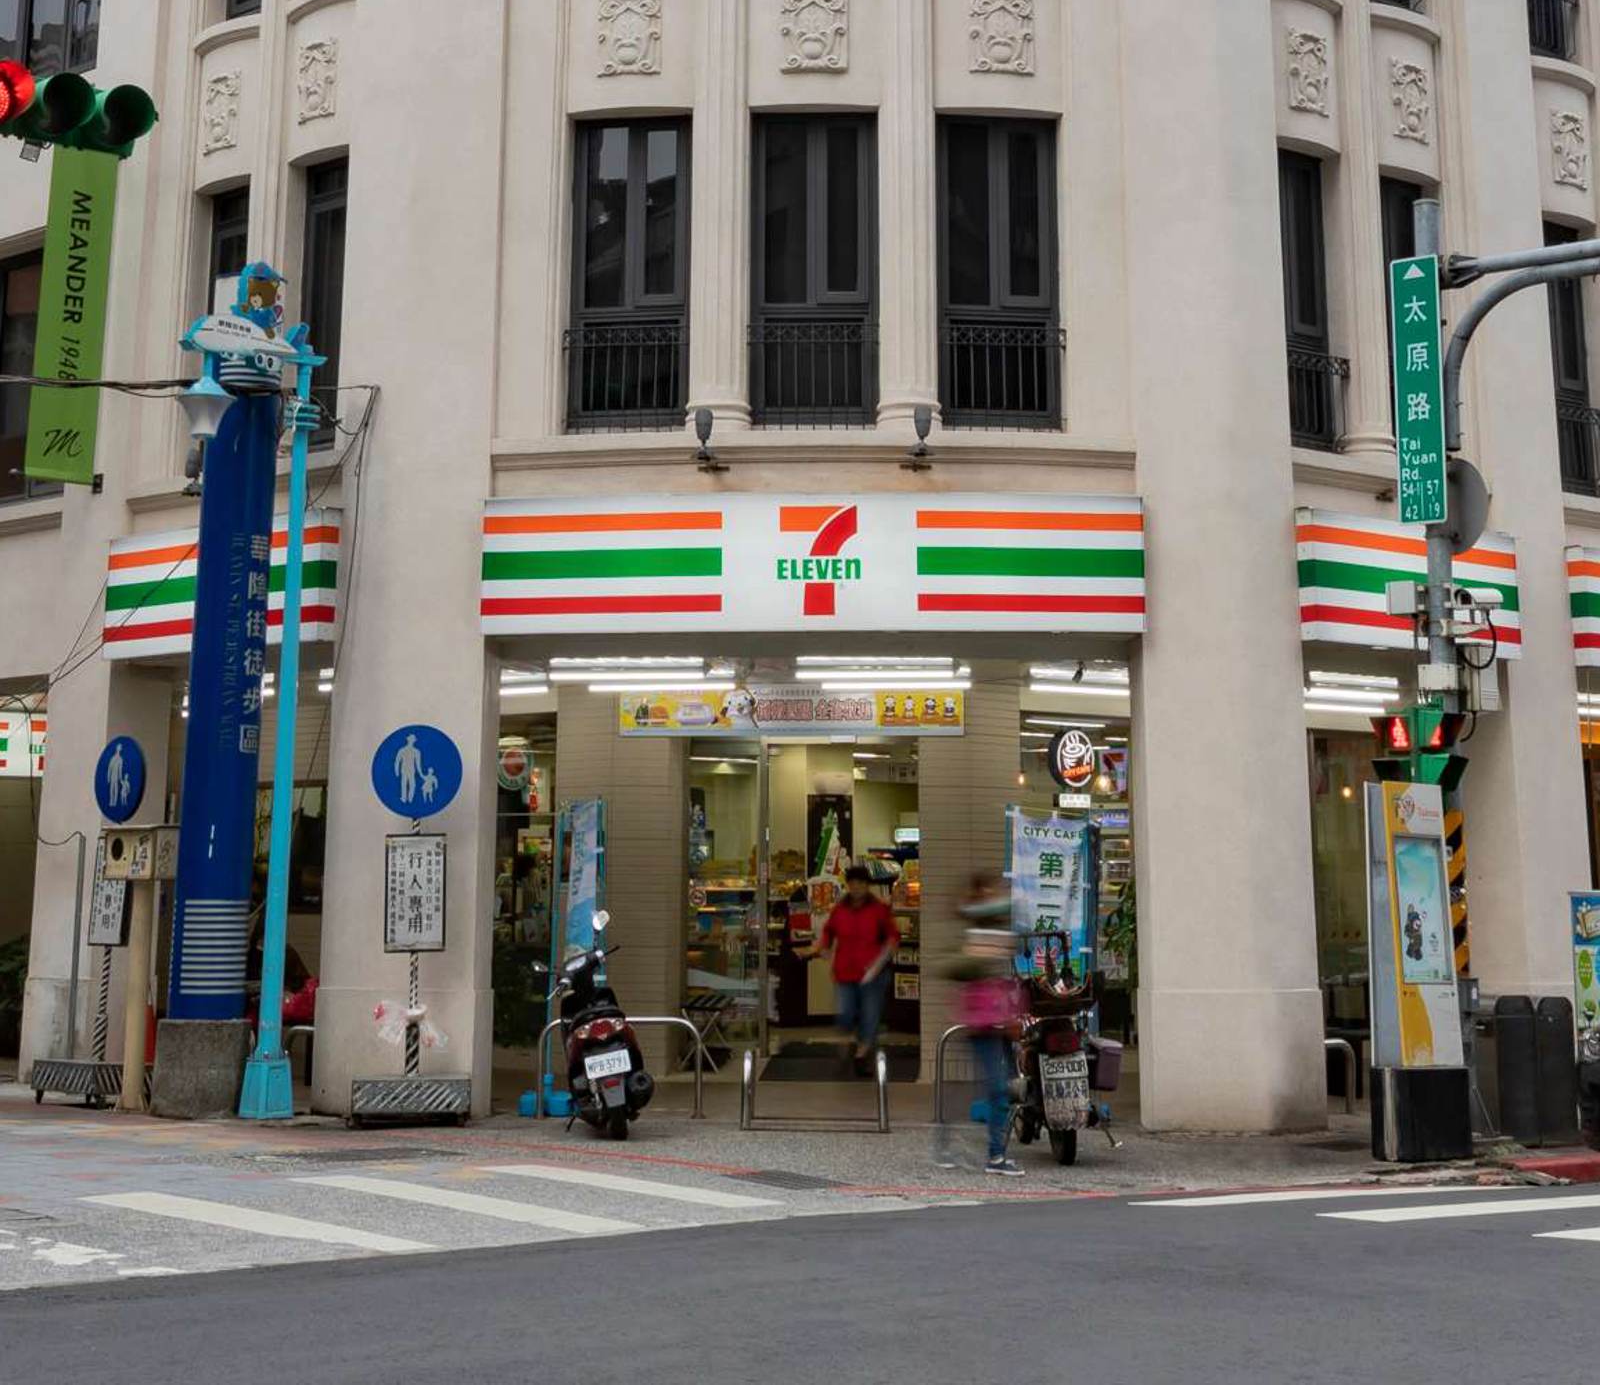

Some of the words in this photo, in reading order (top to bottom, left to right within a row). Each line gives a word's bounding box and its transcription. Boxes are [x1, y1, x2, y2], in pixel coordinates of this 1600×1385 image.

[63, 190, 94, 324] MEANDER
[57, 335, 81, 382] 1948
[1403, 295, 1432, 422] 太原路
[1401, 437, 1421, 451] Tai
[1402, 452, 1438, 467] Yuan
[1401, 467, 1422, 482] Rd.
[1426, 478, 1440, 496] 57
[1405, 504, 1419, 520] 42
[1428, 501, 1441, 518] 19
[779, 505, 858, 616] 7
[239, 533, 269, 754] 華陰街徒步區
[1023, 825, 1050, 837] CITY
[1054, 828, 1085, 840] CAFE
[408, 852, 423, 934] 行人專用
